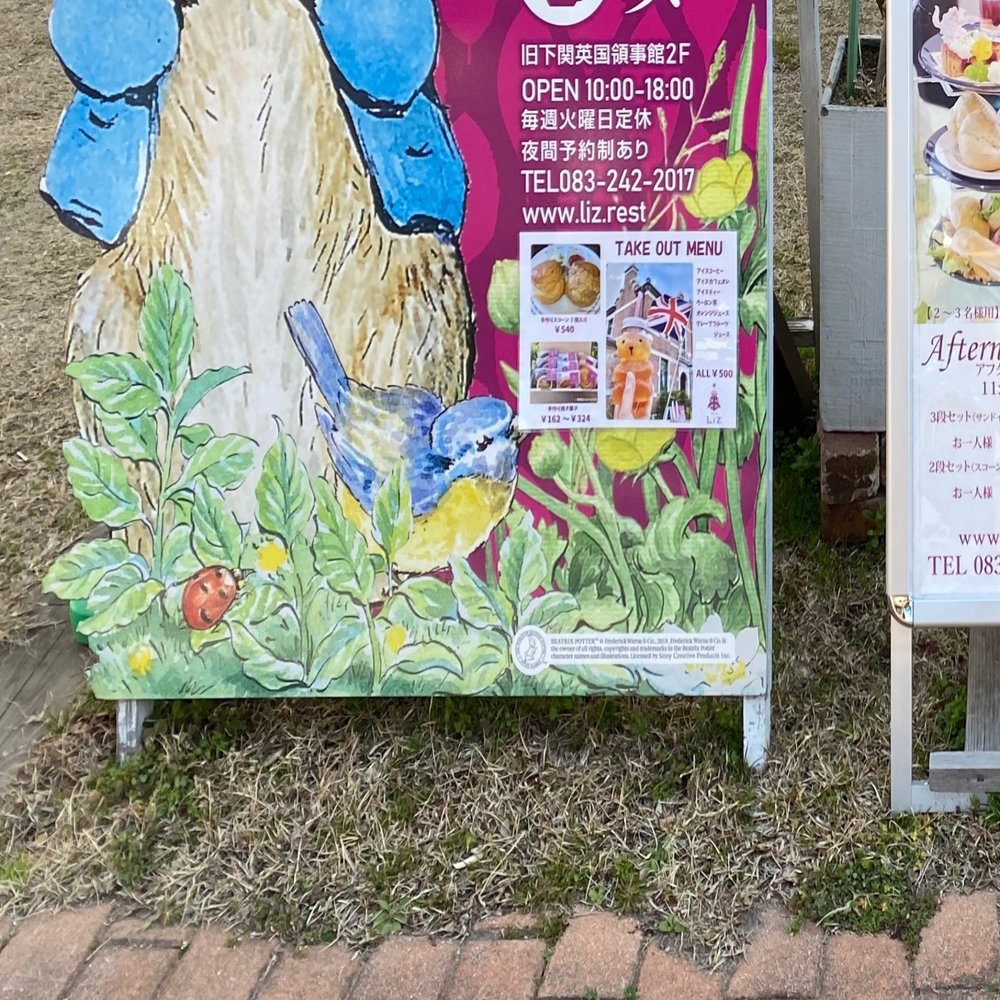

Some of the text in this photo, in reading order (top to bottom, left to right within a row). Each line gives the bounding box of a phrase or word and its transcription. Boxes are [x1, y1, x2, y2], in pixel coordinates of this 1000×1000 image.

[521, 42, 691, 66] 旧下関英国領事館2F
[522, 77, 694, 102] OPEN 10:00-18:00
[521, 108, 652, 131] 毎週火曜日定休
[521, 139, 649, 162] 夜間予約制あり
[522, 200, 647, 224] www.liz.rest
[615, 241, 723, 257] TAKE OUT MENU
[696, 369, 711, 378] ALL
[952, 435, 993, 449] お一人様
[952, 485, 993, 500] お一人様
[928, 555, 968, 575] TEL
